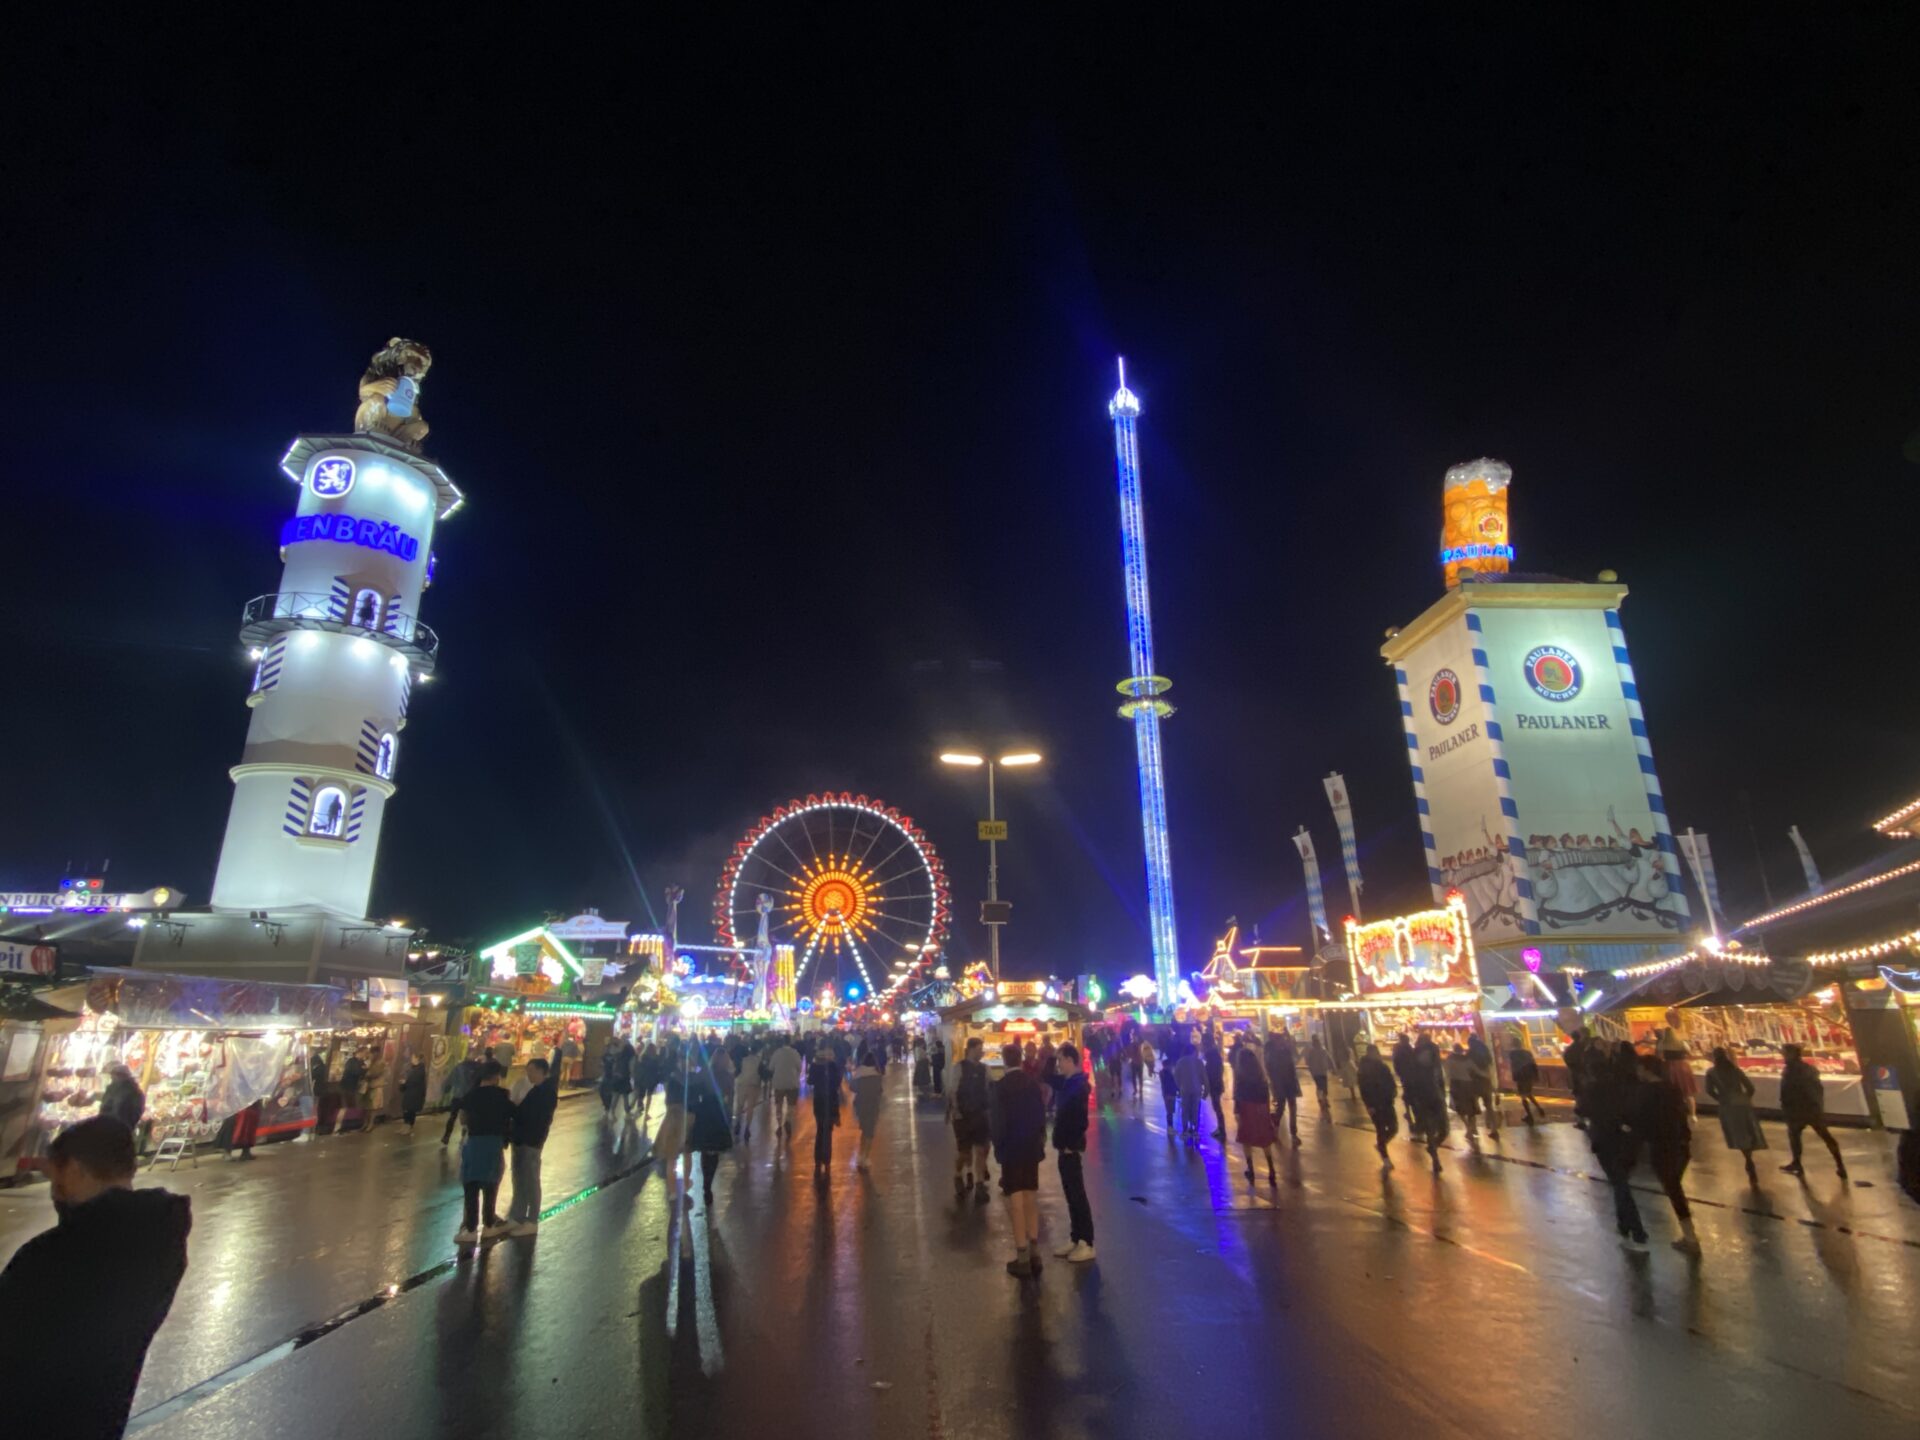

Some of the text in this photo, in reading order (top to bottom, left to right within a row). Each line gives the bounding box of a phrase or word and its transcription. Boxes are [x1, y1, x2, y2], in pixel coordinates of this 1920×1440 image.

[282, 513, 418, 561] ENBRÄU
[1526, 647, 1577, 668] PAULANER
[1515, 713, 1613, 730] PAULANER
[1428, 723, 1480, 761] PAULANER
[75, 893, 127, 906] SEKT
